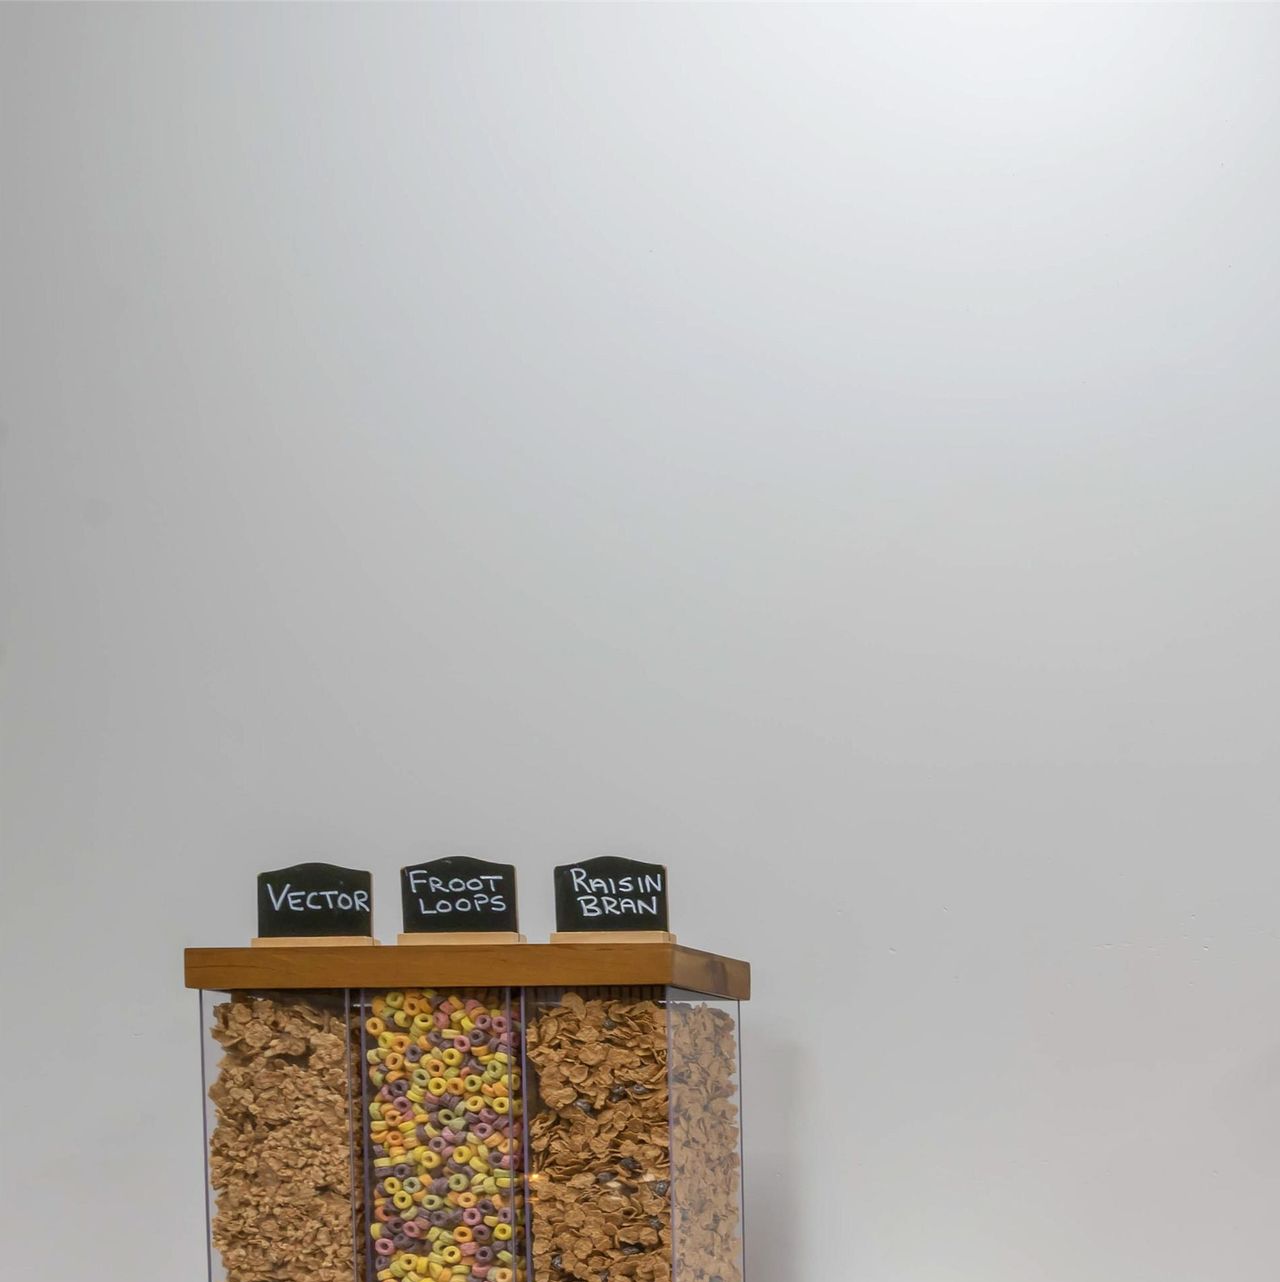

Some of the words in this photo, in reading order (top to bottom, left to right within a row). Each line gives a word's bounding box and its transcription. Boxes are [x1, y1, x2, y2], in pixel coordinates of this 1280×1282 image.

[409, 869, 503, 893] FROOT
[570, 867, 661, 894] RAISIN
[266, 883, 370, 912] VECTOR
[419, 893, 506, 914] LOOPS
[577, 895, 657, 917] BRAN
